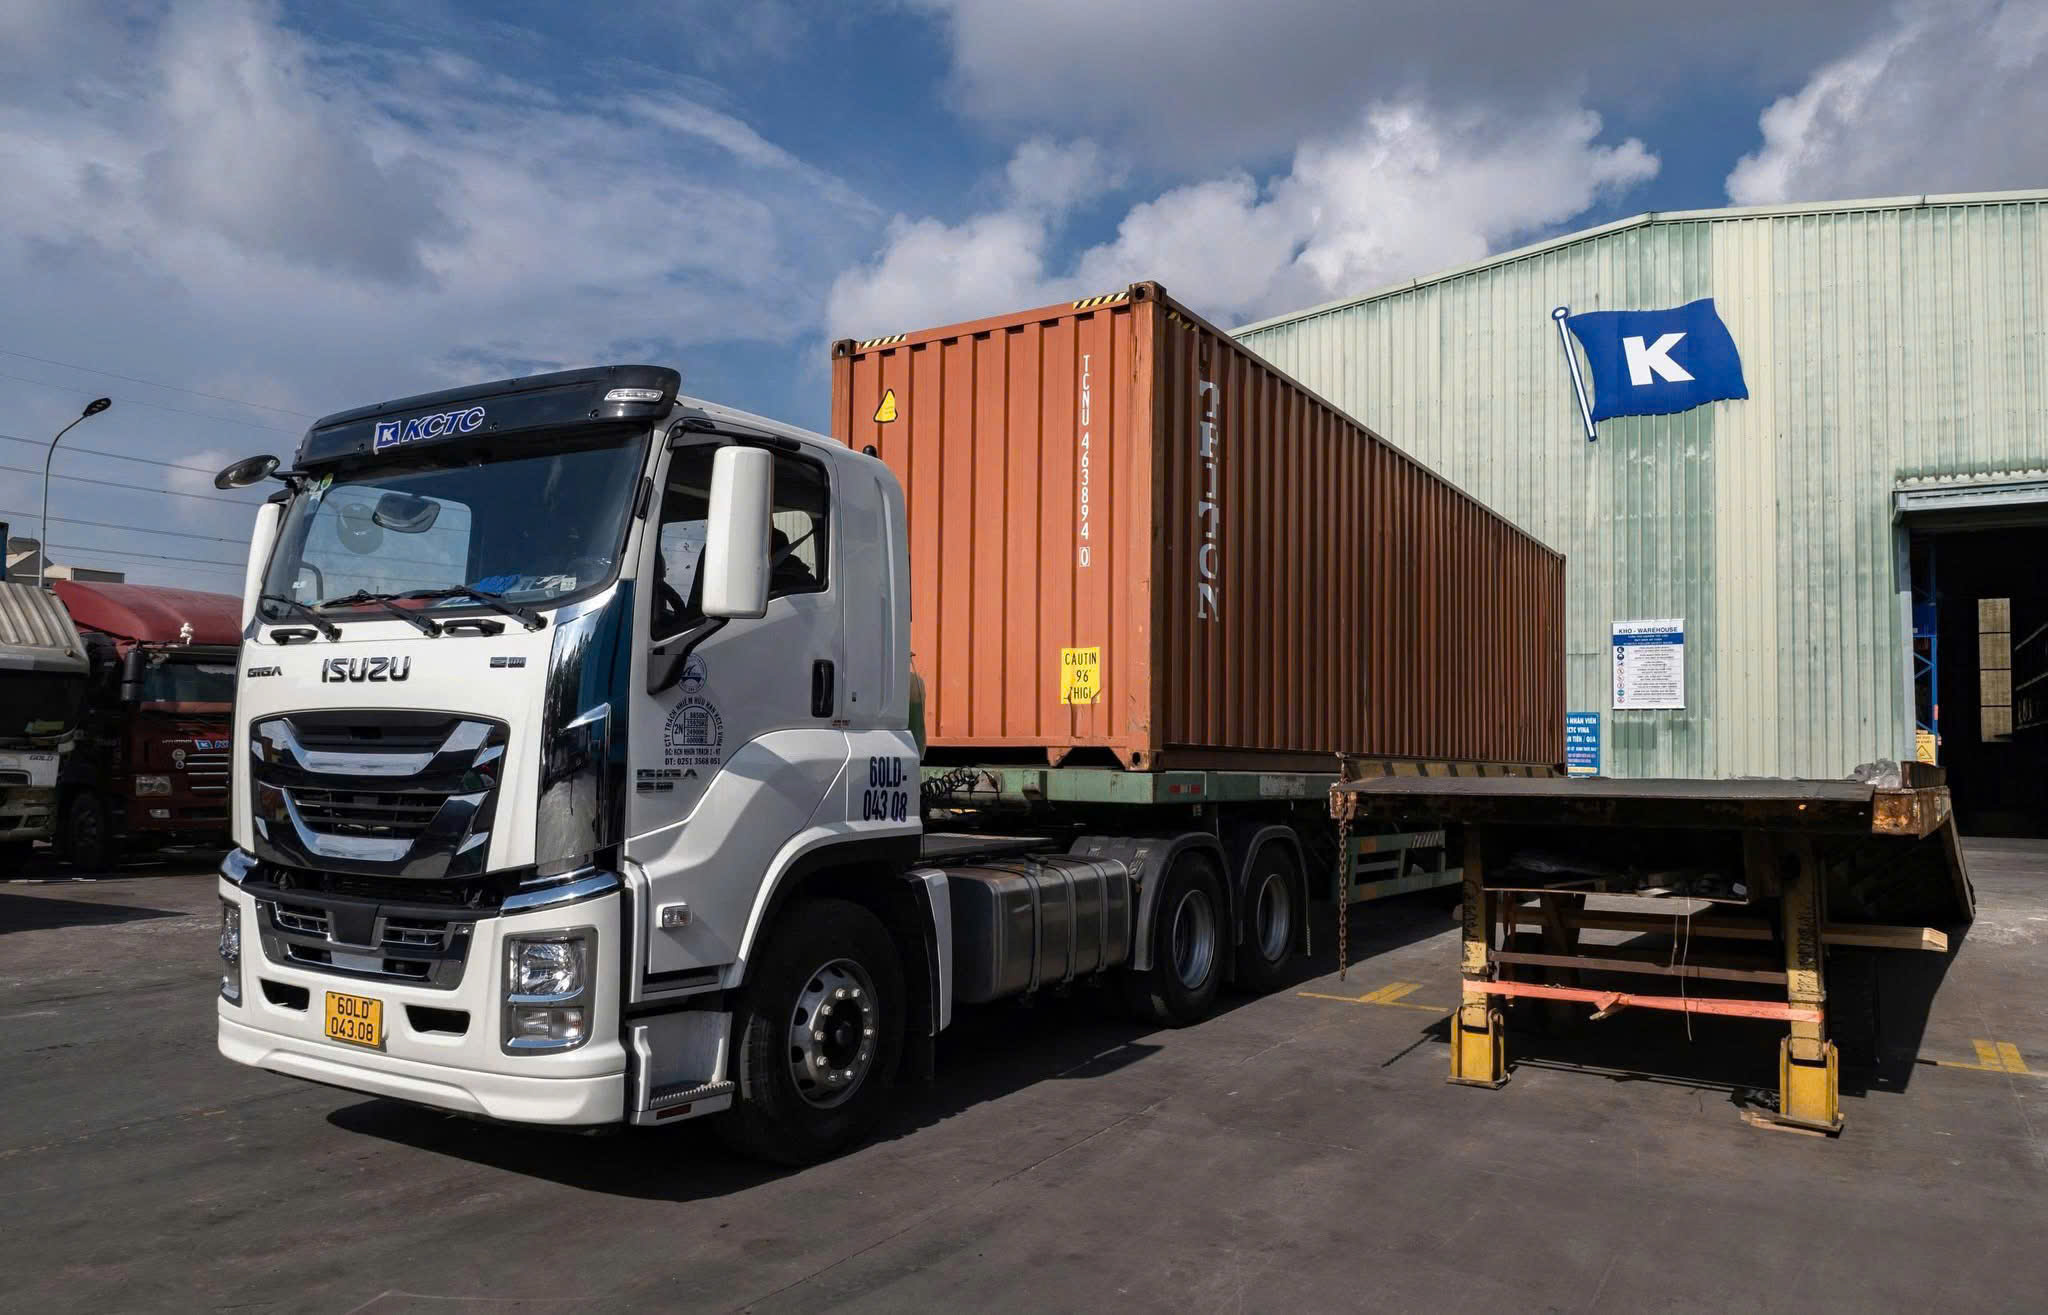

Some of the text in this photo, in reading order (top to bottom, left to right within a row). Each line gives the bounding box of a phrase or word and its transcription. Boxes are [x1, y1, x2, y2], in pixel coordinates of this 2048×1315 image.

[1623, 332, 1696, 386] K
[1082, 354, 1090, 426] TCNU
[401, 406, 486, 443] KCTC
[1081, 431, 1089, 540] 463894
[247, 656, 411, 683] GIGA ISUZU
[863, 790, 908, 823] 043 08
[338, 997, 369, 1019] 60LD
[331, 1017, 373, 1041] 043.08
